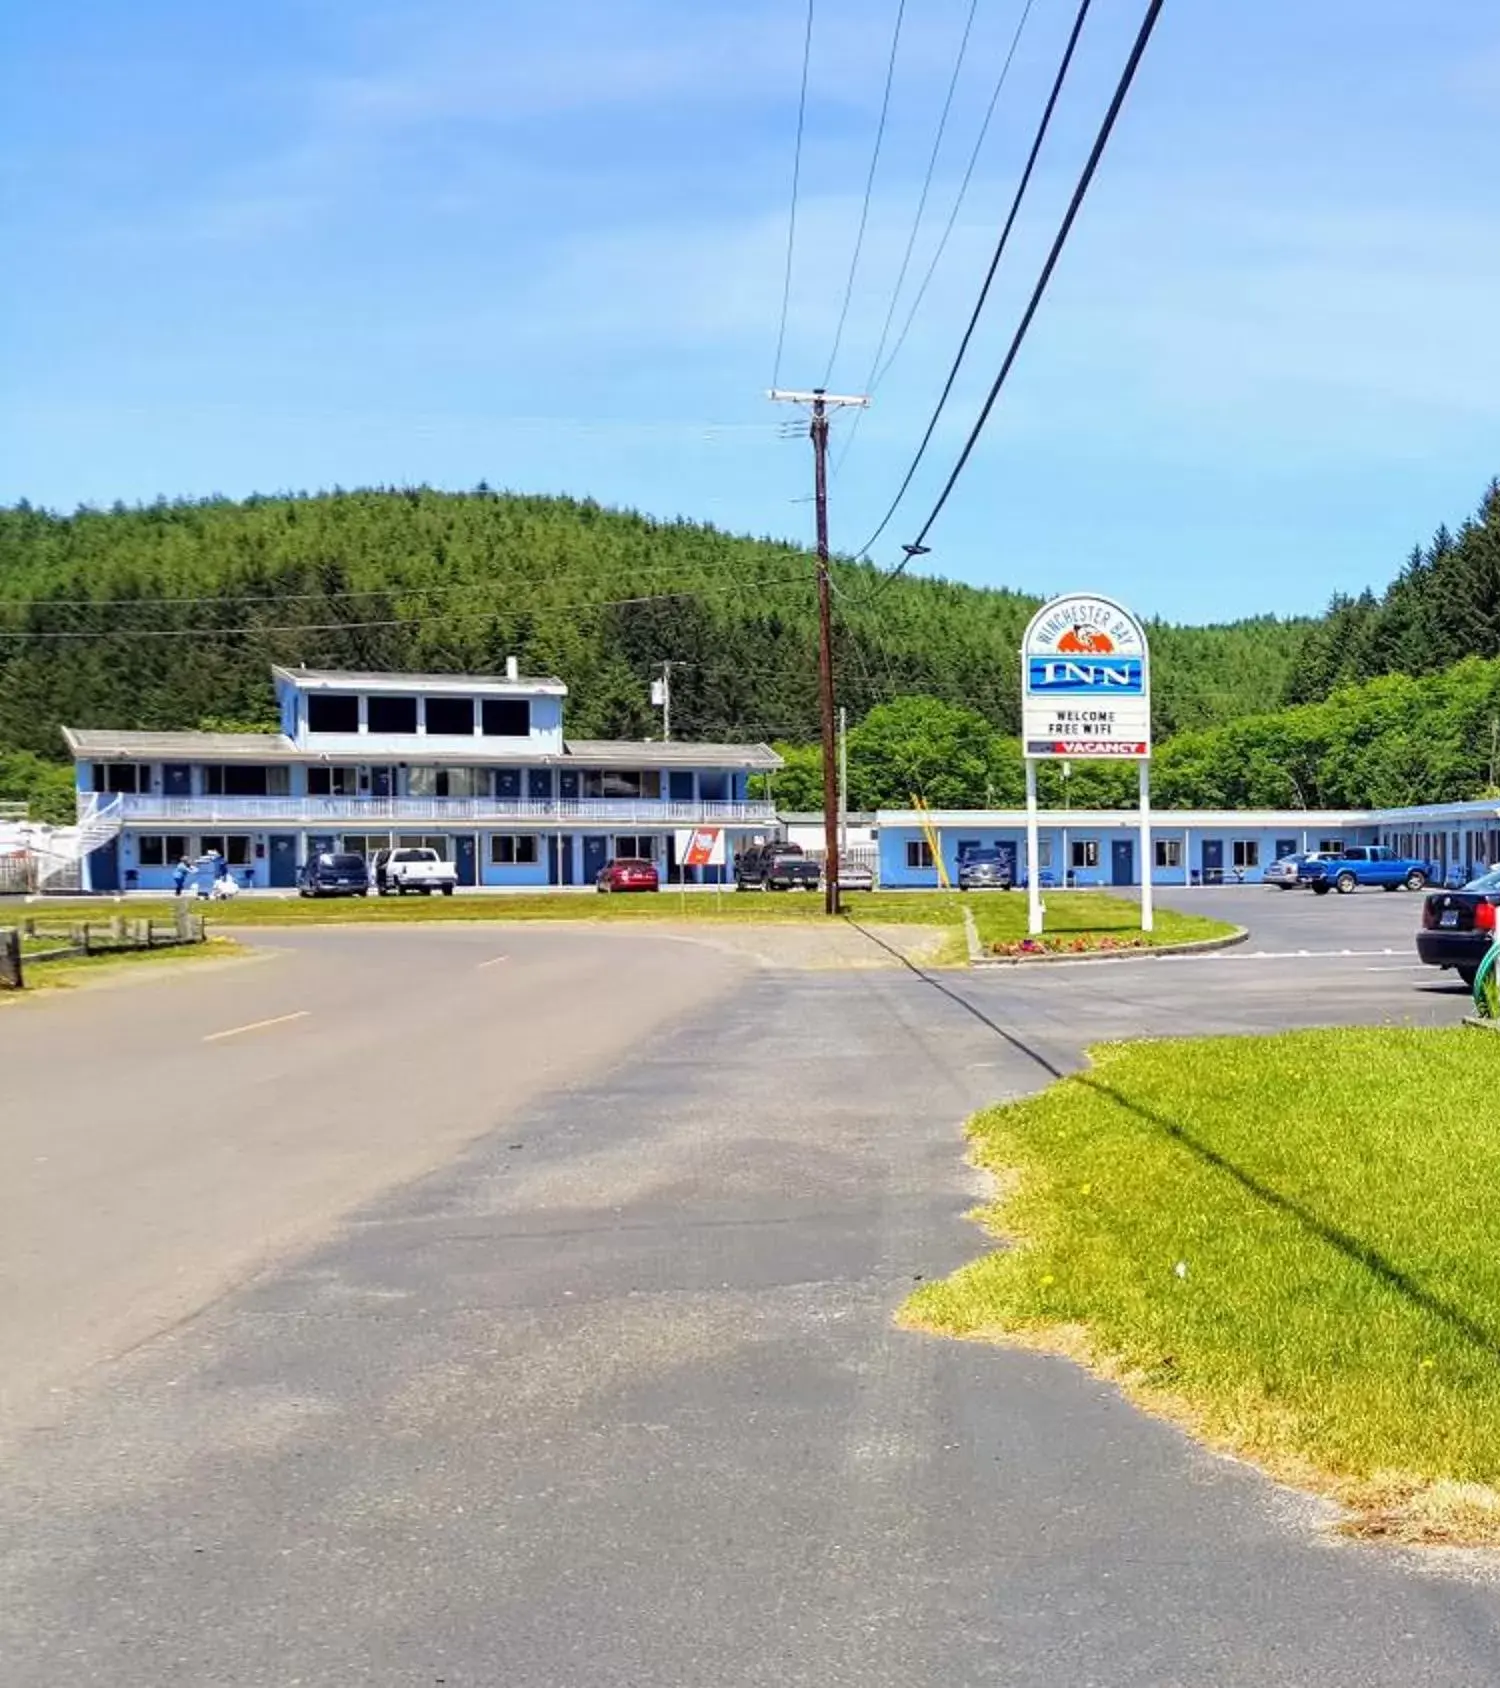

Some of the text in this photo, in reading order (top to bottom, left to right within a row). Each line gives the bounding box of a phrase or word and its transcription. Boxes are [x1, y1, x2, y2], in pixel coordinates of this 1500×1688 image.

[1036, 605, 1135, 645] WINCHESTER BAY
[1043, 662, 1131, 687] INN
[1056, 710, 1116, 722] WELCOME
[1048, 723, 1112, 735] FREE WIFI
[1062, 743, 1138, 754] VACANCY
